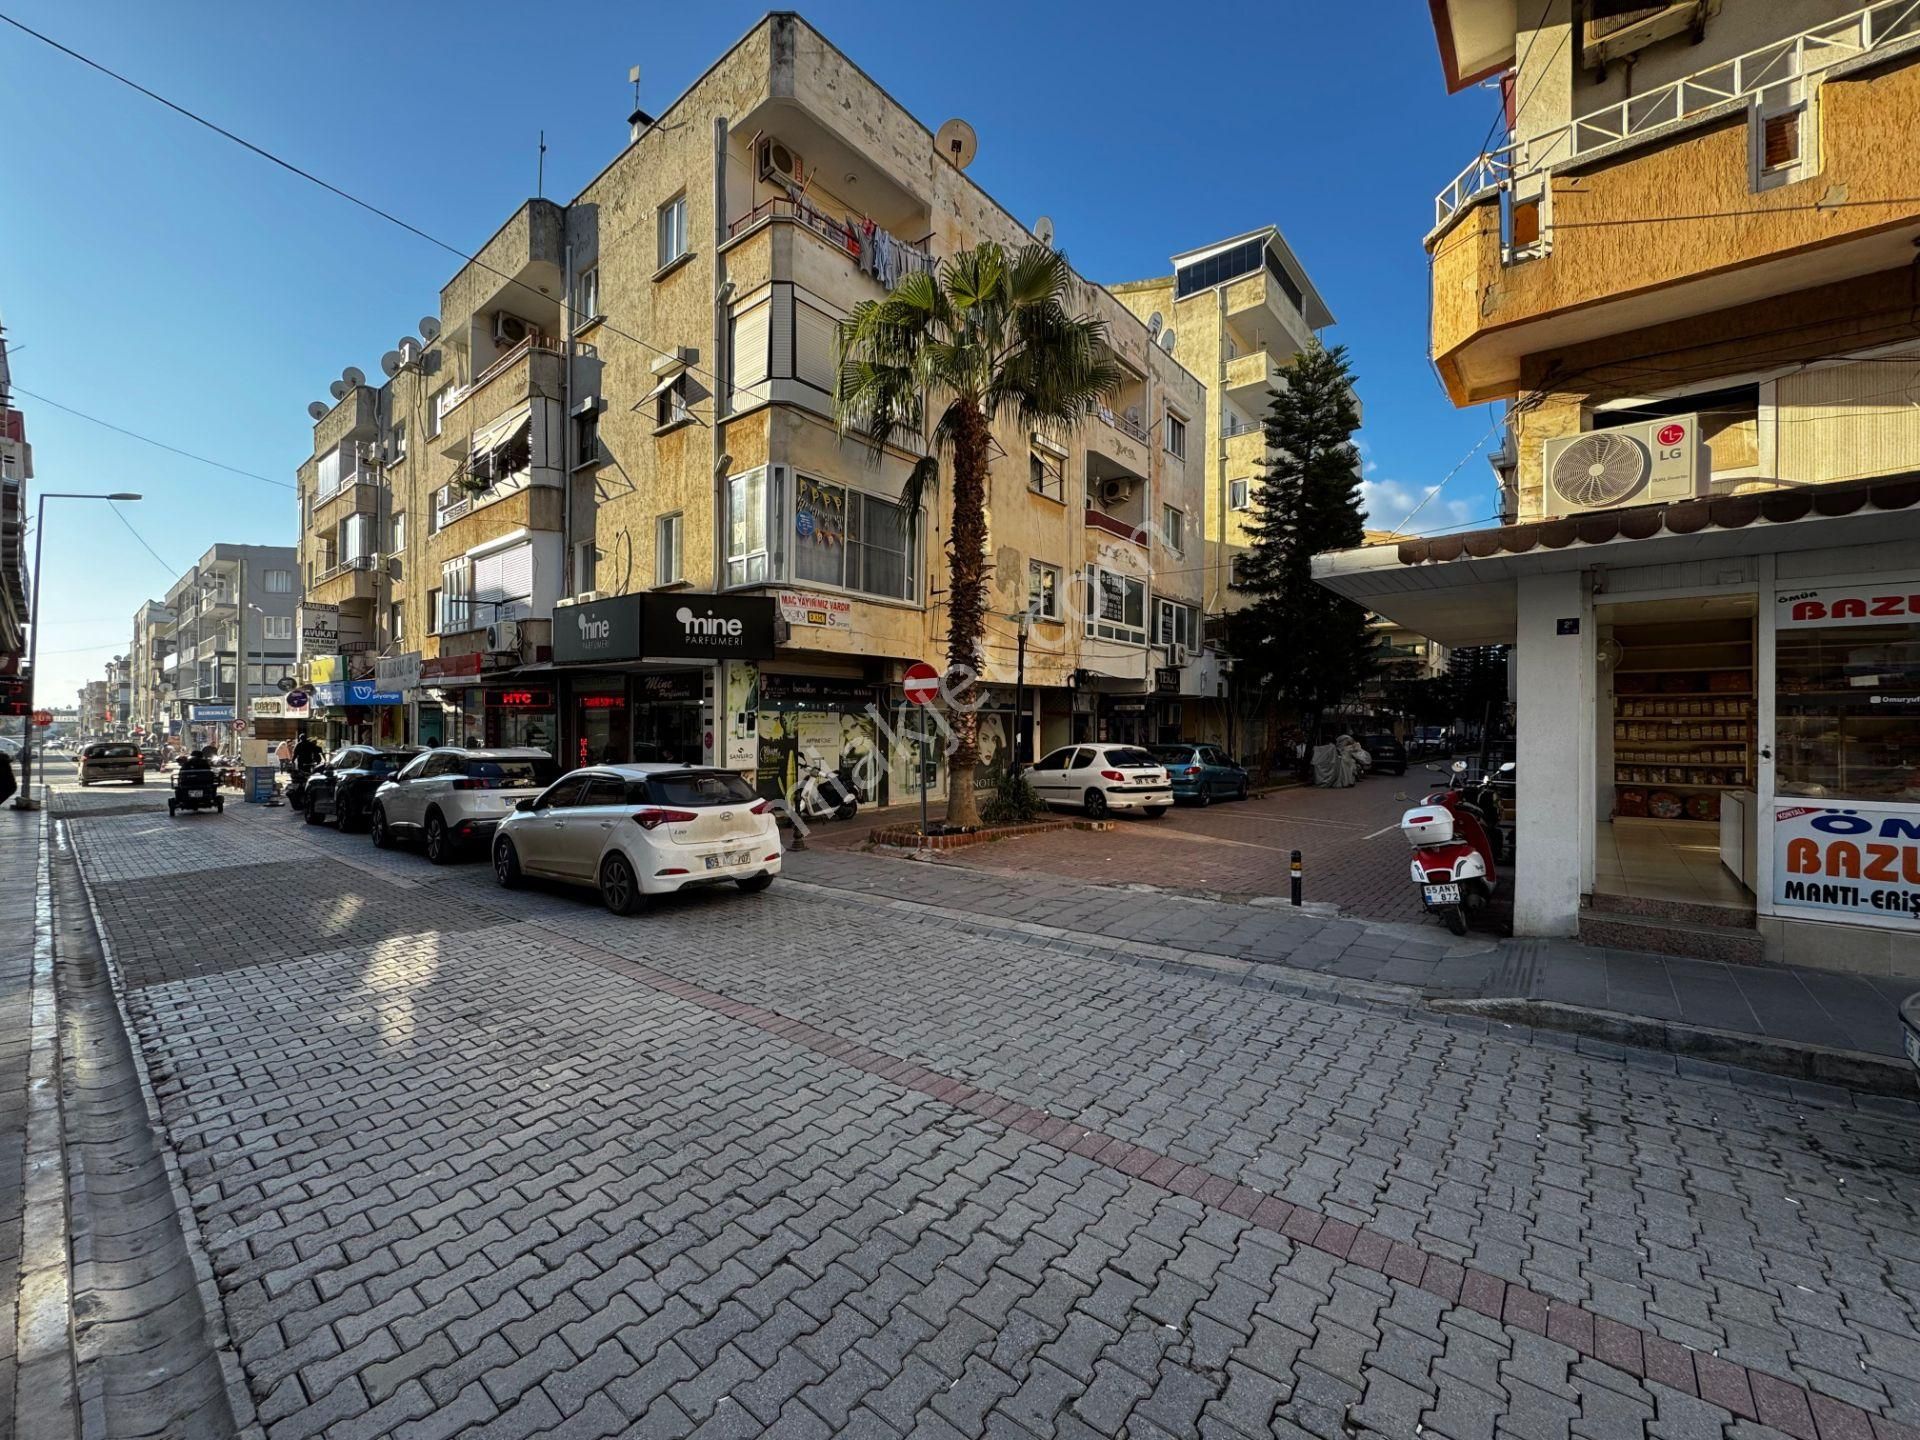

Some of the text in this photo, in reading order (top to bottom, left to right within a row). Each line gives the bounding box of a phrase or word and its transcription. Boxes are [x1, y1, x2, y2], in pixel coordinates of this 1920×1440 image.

[1660, 448, 1682, 461] LG
[678, 608, 743, 636] mine
[304, 630, 337, 638] AVUKAT
[685, 636, 743, 646] PARFÜMERİ
[1777, 807, 1805, 820] KONYALI
[1441, 893, 1459, 901] 872
